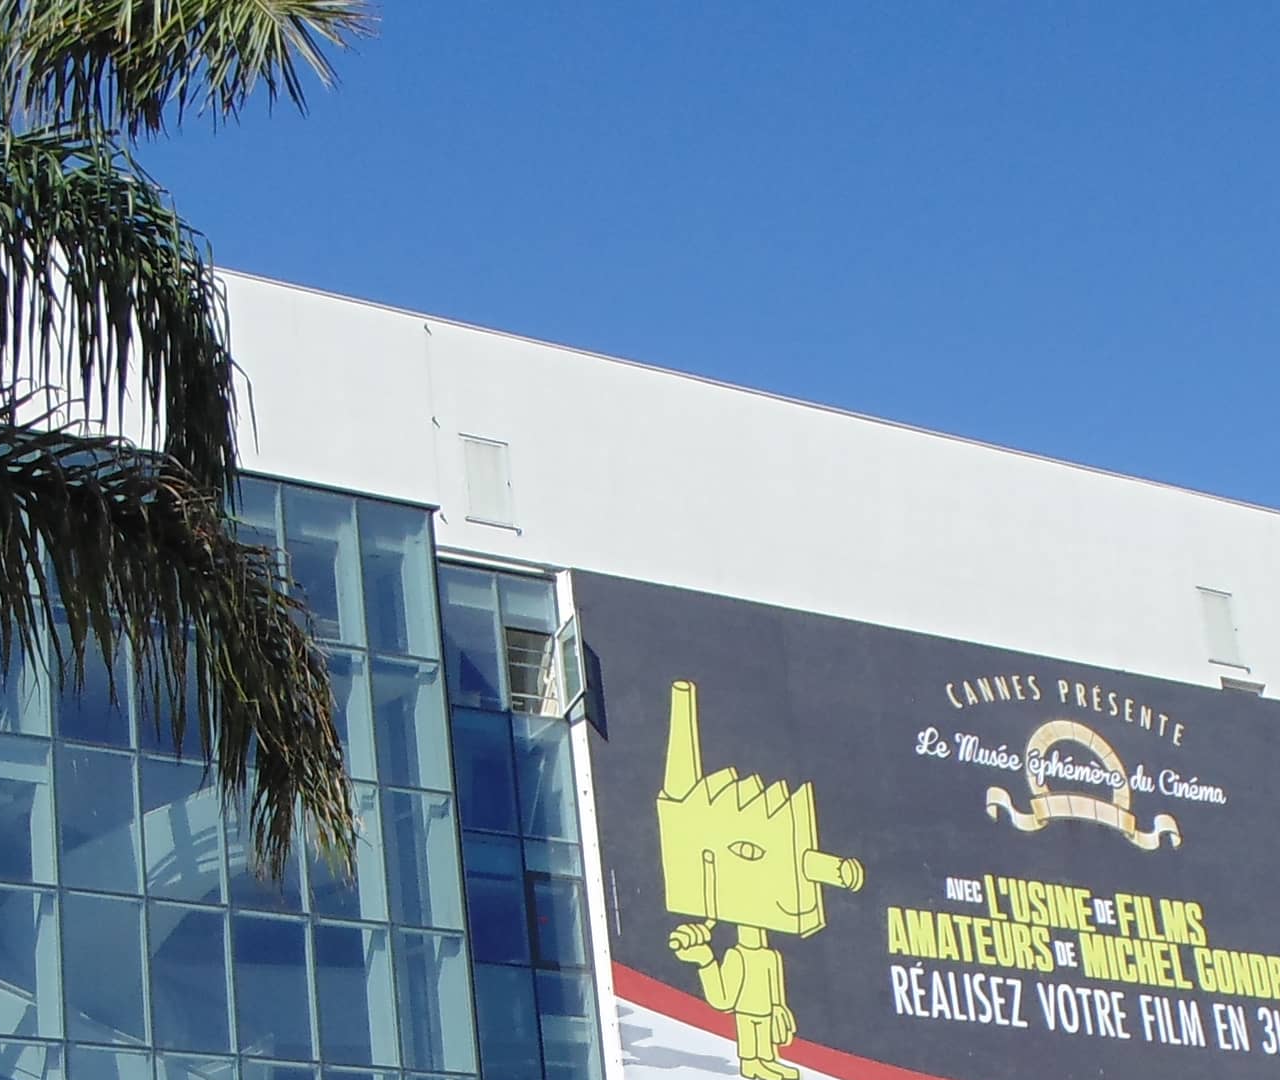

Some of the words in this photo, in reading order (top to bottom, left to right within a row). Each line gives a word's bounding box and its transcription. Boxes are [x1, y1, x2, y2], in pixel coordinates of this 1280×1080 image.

[945, 673, 1042, 709] CANNES
[1057, 678, 1185, 747] PRÉSENTE
[915, 726, 951, 758] Le
[955, 732, 1023, 770] Musée
[1028, 749, 1124, 787] éphémère
[1130, 764, 1155, 792] du
[1159, 769, 1227, 804] Cinéma
[887, 907, 1055, 973] AMATEURS
[1054, 940, 1077, 968] DE
[1079, 932, 1193, 990] MICHEL
[945, 876, 983, 904] AVEC
[984, 874, 1097, 934] L'USINE
[1094, 898, 1116, 926] DE
[1114, 892, 1208, 947] FILMS
[890, 961, 1028, 1029] RÉALISEZ
[1036, 982, 1131, 1040] VOTRE
[1140, 994, 1207, 1048] FILM
[1213, 1002, 1250, 1052] EN
